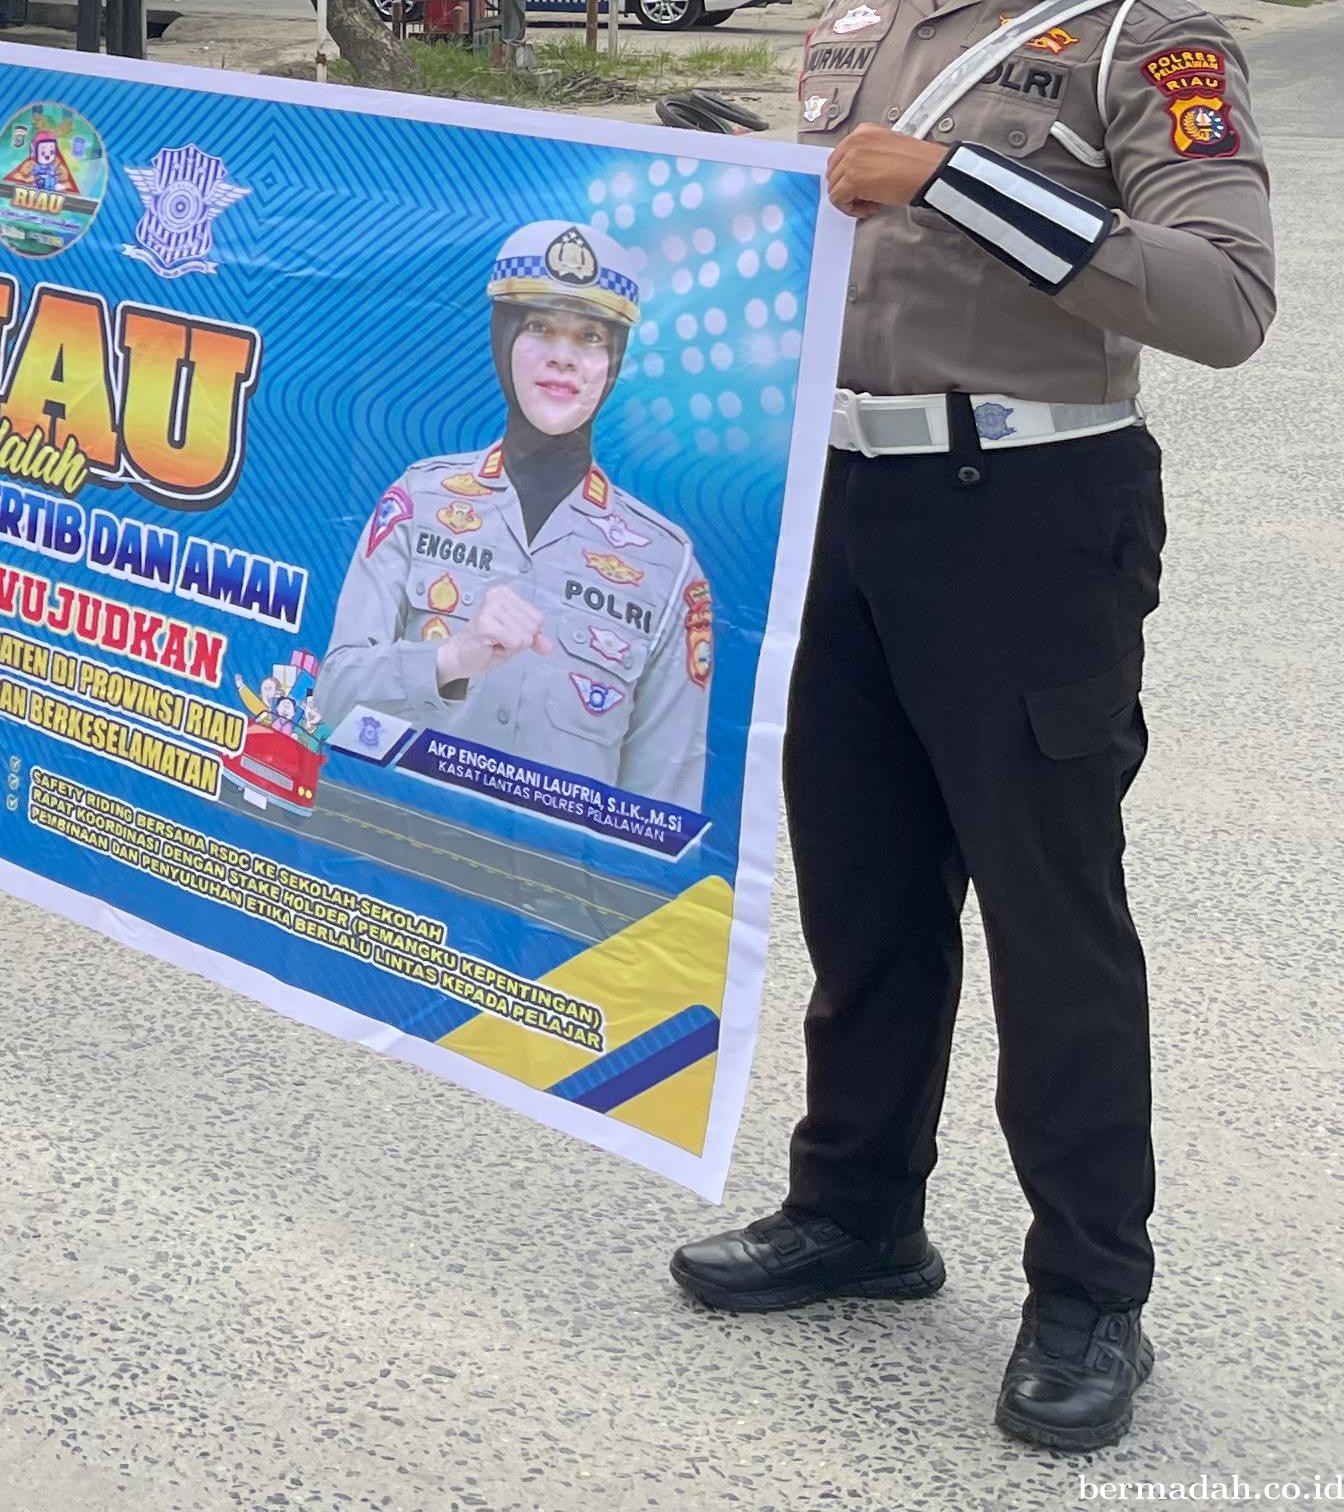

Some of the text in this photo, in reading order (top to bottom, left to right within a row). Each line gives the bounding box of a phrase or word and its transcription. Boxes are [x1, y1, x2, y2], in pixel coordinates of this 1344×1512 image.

[979, 61, 1063, 100] OLRI
[1147, 52, 1217, 74] POLRES
[1166, 76, 1218, 90] RIAU
[12, 187, 65, 215] RIAU
[90, 514, 175, 584] DAN
[178, 540, 306, 627] AMAN
[415, 531, 493, 572] ENGGAR
[564, 578, 652, 634] POLRI
[51, 651, 77, 687] DI
[79, 662, 185, 729] PROVINSI
[187, 703, 245, 752] RIAU
[29, 693, 222, 797] BERKESELAMATAN
[428, 739, 605, 808] AKP ENGGARANI LAUFRIA,
[33, 769, 84, 802] SAFETY
[85, 791, 133, 823] RIDING
[135, 809, 207, 854] BERSAMA
[208, 840, 251, 871] RSDC
[252, 857, 278, 881] KE
[438, 760, 664, 843] KASAT LANTAS POLRES PELALAWAN
[30, 805, 605, 1053] PEMBINAAN DAN PENYULUHAN ETIKA BERLALU LINTAS KEPADA PELAJAR
[32, 787, 602, 1031] RAPAT KOORDINASI DENGAN STAKE HOLDER (PEMANGKU KEPENTINGAN)
